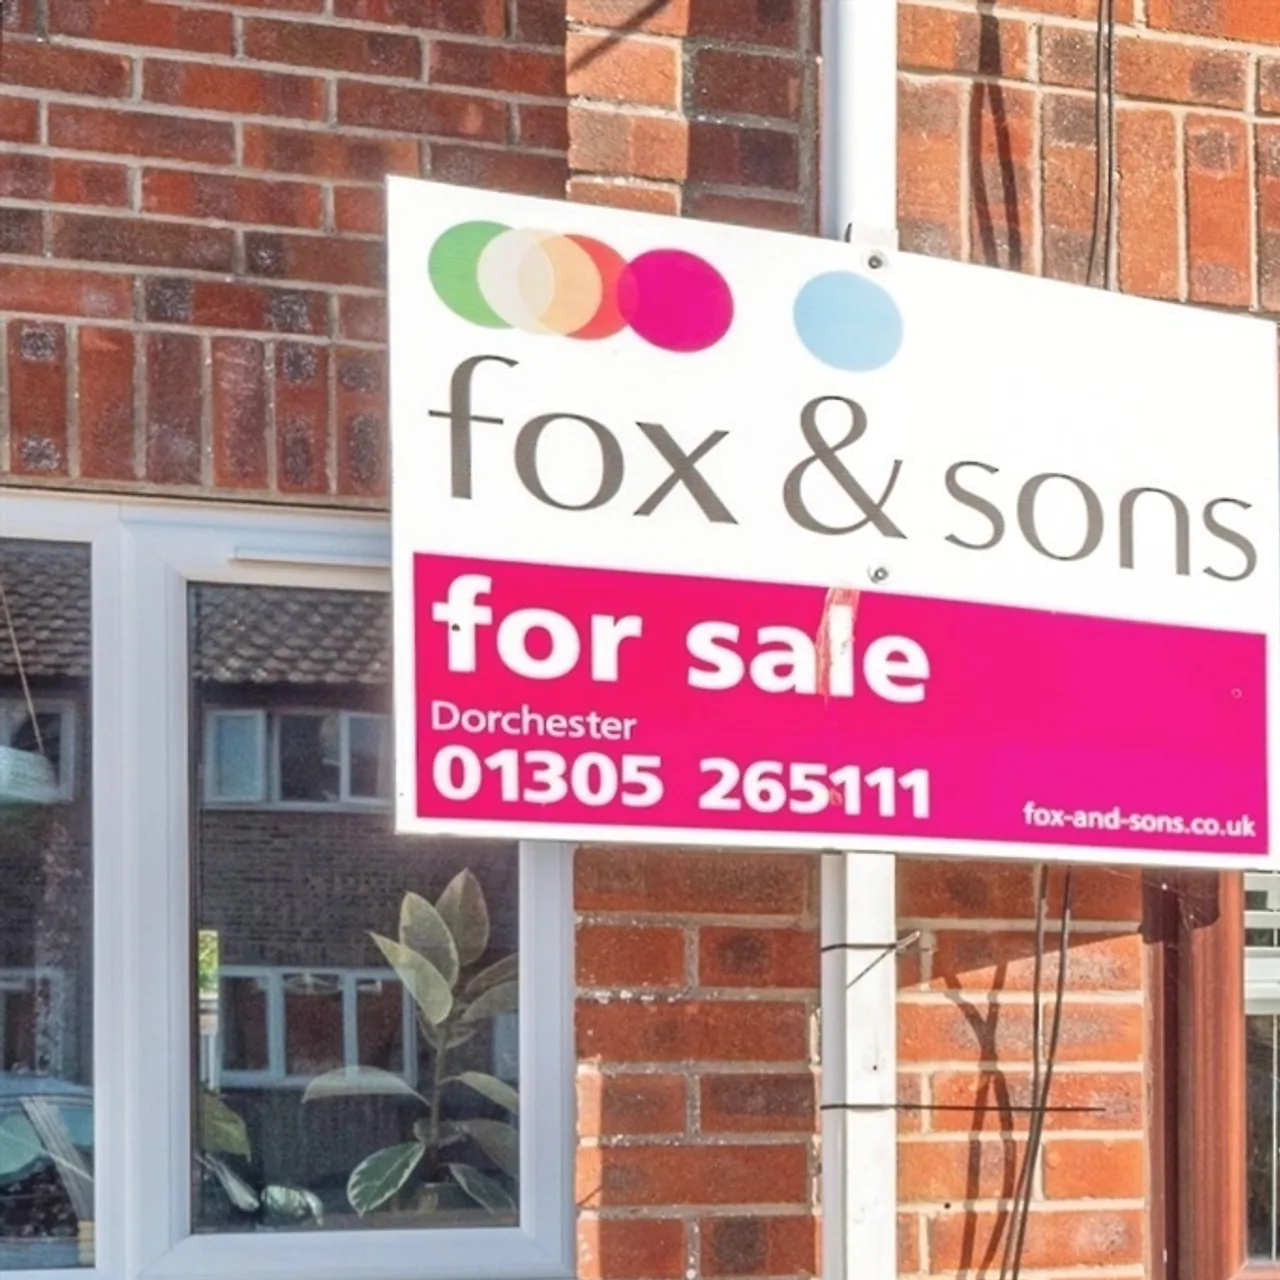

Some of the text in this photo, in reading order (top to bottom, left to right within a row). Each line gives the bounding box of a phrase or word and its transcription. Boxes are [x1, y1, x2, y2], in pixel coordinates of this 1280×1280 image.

[427, 354, 1258, 582] fox & sons
[432, 574, 931, 703] for sale
[431, 701, 637, 741] Dorchester
[433, 745, 931, 819] 01305 265111
[1023, 801, 1257, 837] fox-and-sons.co.uk
